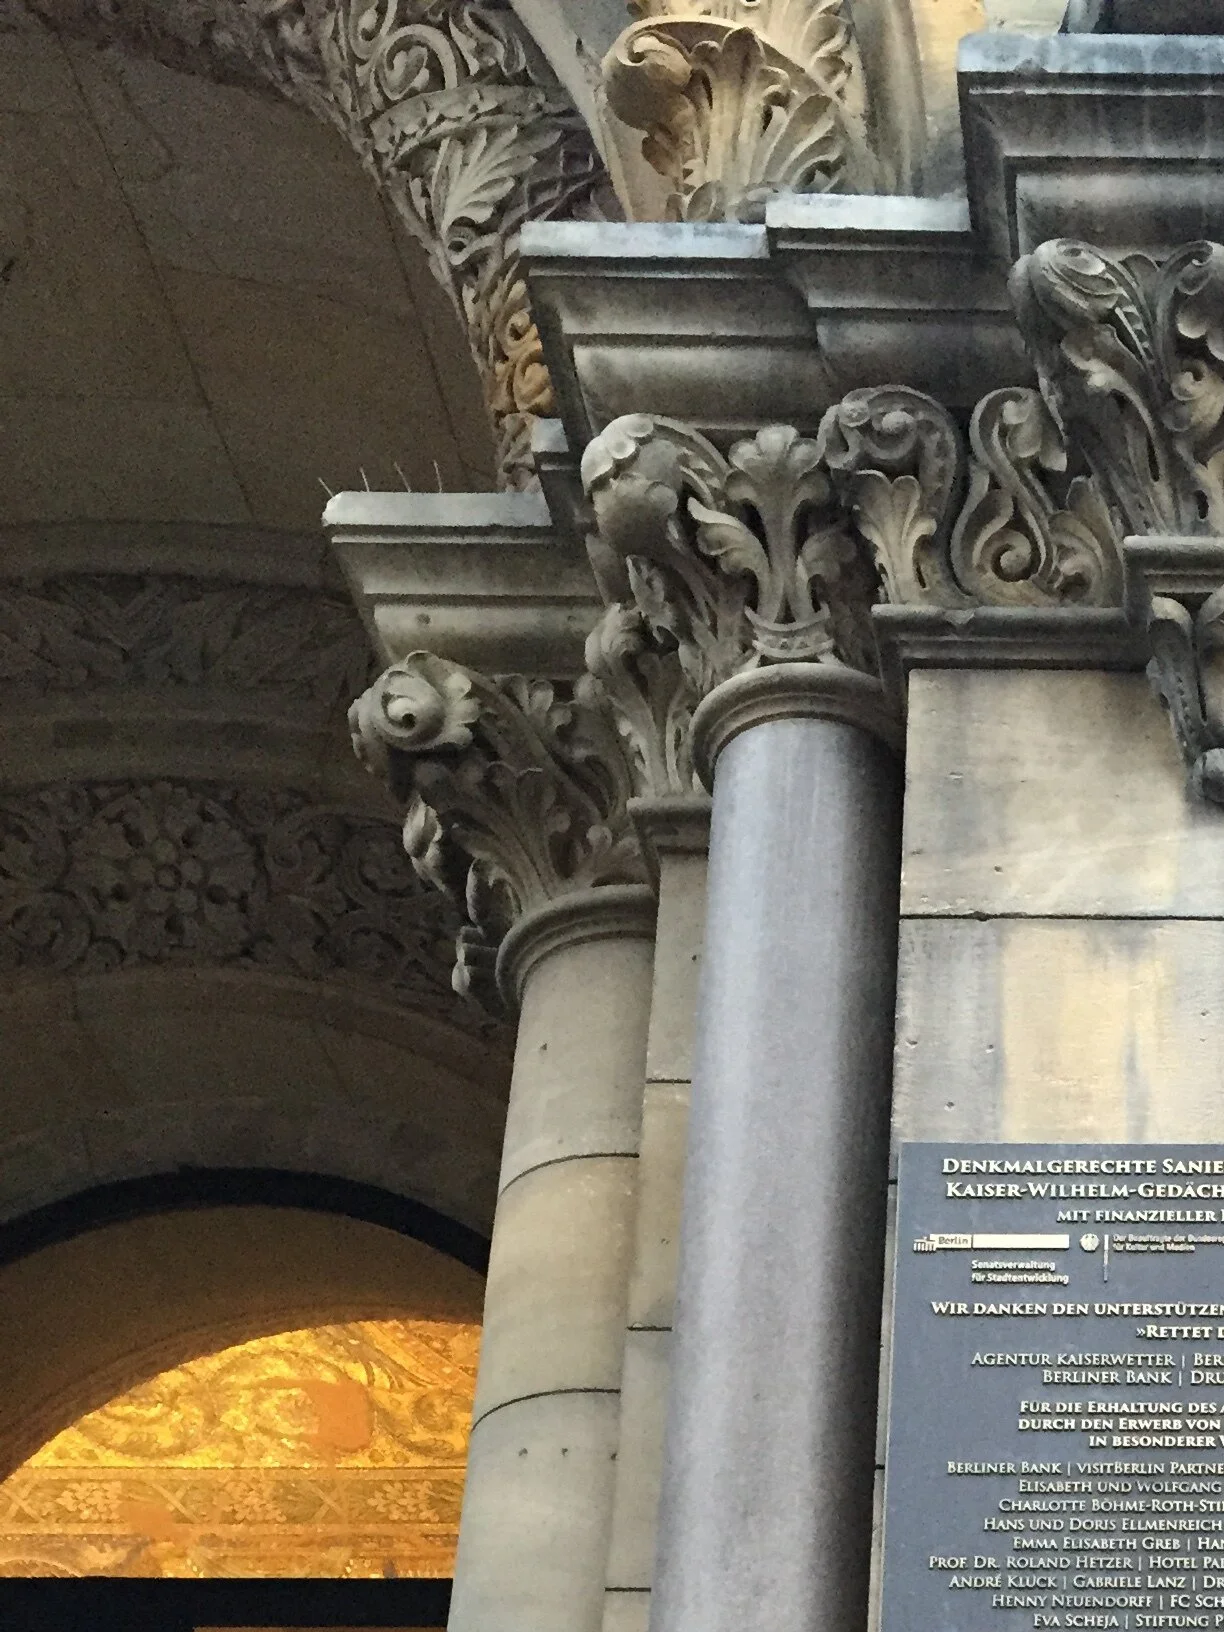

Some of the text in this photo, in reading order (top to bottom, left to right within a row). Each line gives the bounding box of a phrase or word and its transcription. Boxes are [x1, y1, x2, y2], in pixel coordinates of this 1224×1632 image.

[943, 1158, 1157, 1174] DENKMALGERECHTE
[1057, 1209, 1092, 1221] MIT
[1095, 1209, 1218, 1221] FINANZIELLER
[937, 1236, 970, 1246] Berlin
[970, 1259, 1057, 1272] Senatsverwaltung
[970, 1272, 1070, 1285] für Stadtentwicklung
[931, 1300, 970, 1314] WIR
[972, 1302, 1048, 1315] DANKEN
[1051, 1302, 1090, 1315] DEN
[1054, 1401, 1083, 1413] DIE
[1087, 1400, 1183, 1413] ERHALTUNG
[1188, 1401, 1218, 1413] DES
[1018, 1418, 1076, 1430] DURCH
[1080, 1418, 1114, 1430] DEN
[1118, 1417, 1183, 1430] ERWERB
[1185, 1418, 1221, 1430] VON
[1089, 1435, 1108, 1447] IN
[1111, 1434, 1217, 1447] BESONDERER
